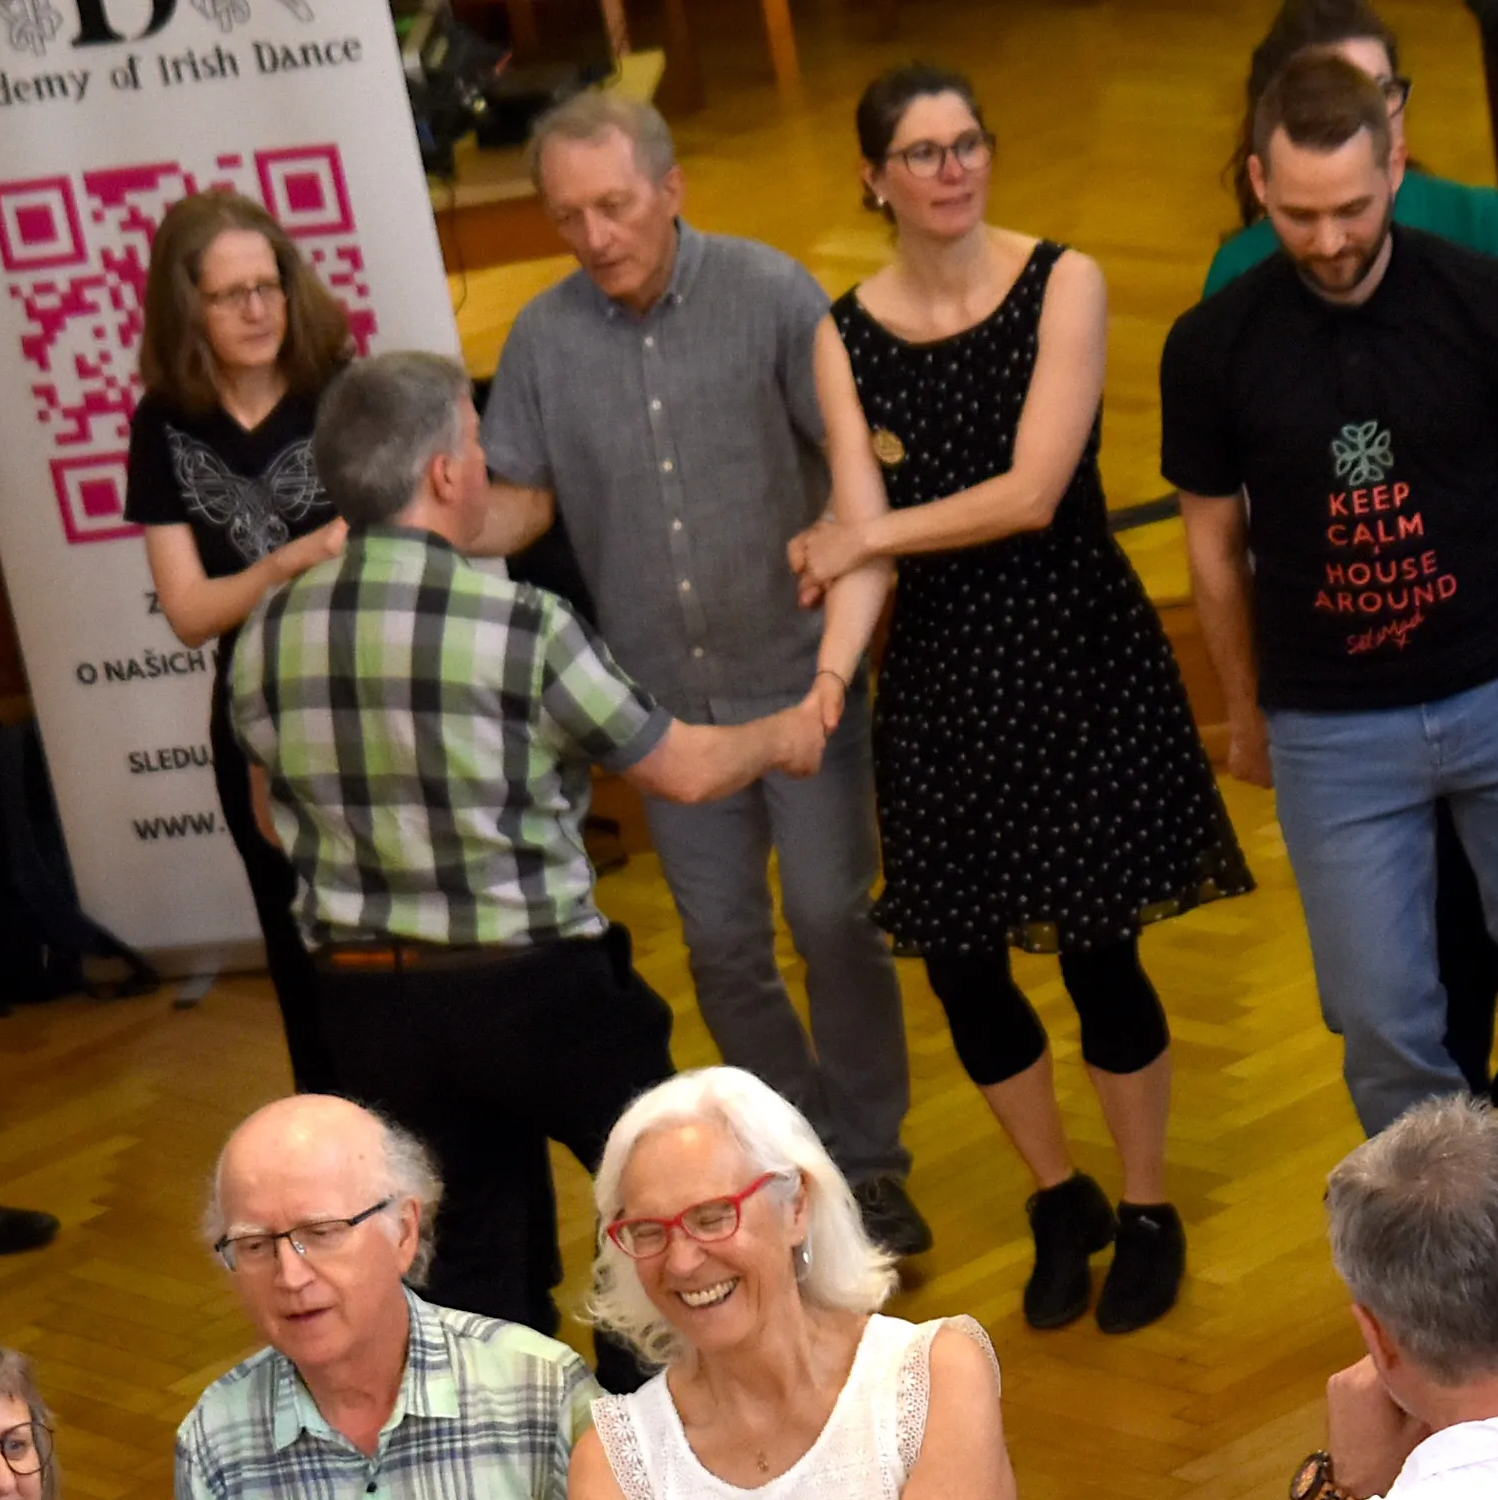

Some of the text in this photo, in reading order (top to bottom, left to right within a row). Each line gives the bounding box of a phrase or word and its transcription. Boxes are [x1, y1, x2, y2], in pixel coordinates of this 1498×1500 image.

[110, 53, 140, 91] of
[158, 46, 240, 88] Irish
[253, 35, 364, 75] Dance
[1329, 482, 1410, 517] KEEP
[1327, 512, 1424, 545] CALM
[1326, 550, 1437, 584] HOUSE
[1315, 574, 1457, 612] AROUND
[76, 661, 99, 686] O
[103, 648, 206, 683] NAŠICH
[129, 746, 213, 774] SLEDU
